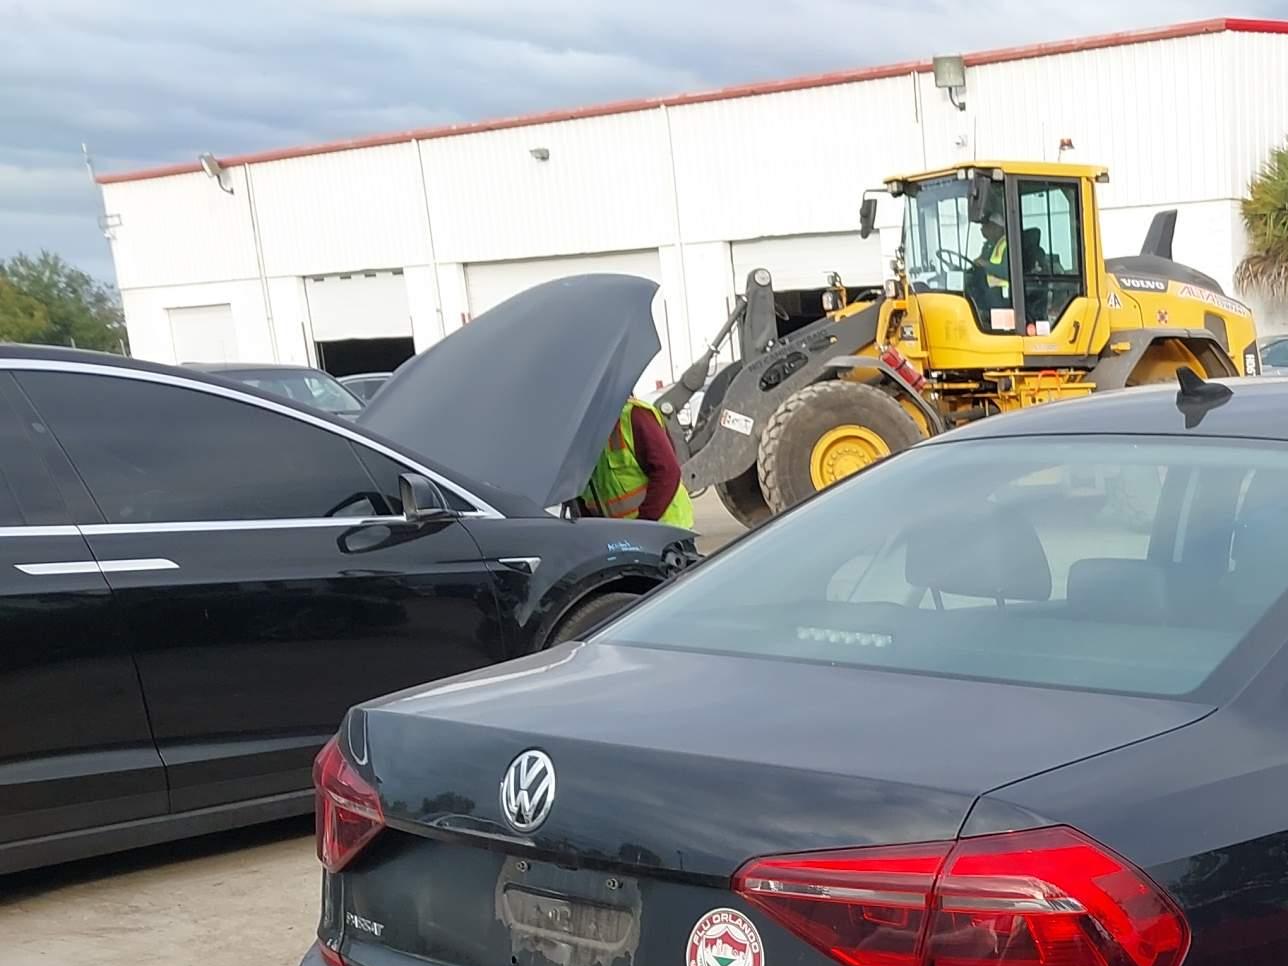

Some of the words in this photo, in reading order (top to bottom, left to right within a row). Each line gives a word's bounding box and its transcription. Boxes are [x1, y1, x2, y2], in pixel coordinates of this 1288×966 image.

[1120, 277, 1166, 291] VOLVO
[345, 911, 385, 937] PASSAT
[692, 920, 712, 946] FLU
[712, 912, 760, 954] ORLANDO
